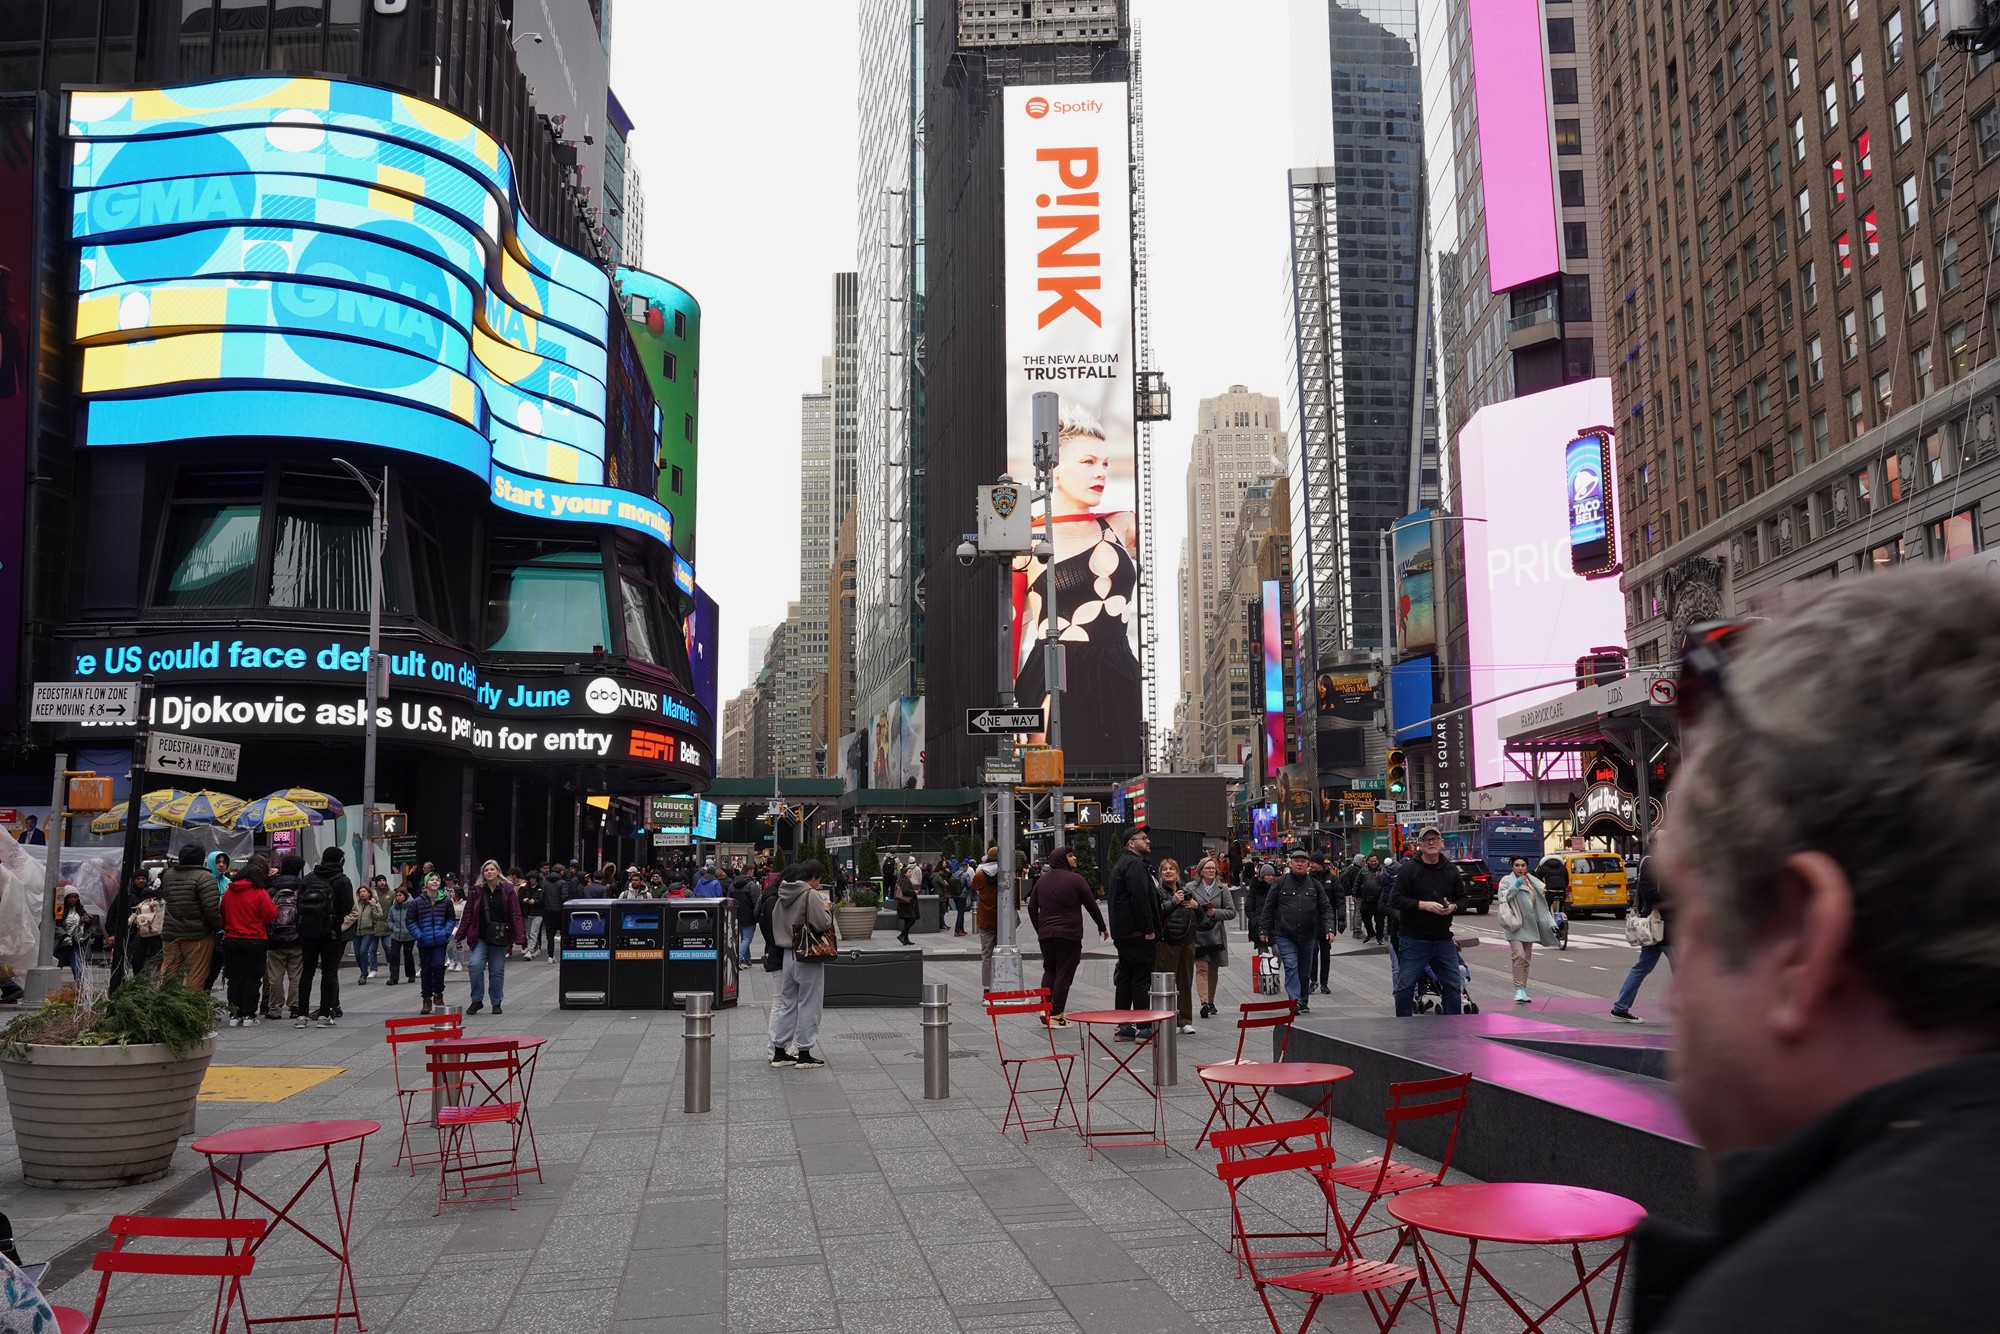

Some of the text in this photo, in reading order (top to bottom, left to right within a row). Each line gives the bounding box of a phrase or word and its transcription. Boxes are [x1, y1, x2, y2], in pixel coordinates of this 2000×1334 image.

[1053, 99, 1103, 115] Spotify
[93, 176, 245, 230] GMA
[1036, 147, 1102, 331] P!NK
[278, 262, 438, 349] GMA
[1023, 354, 1119, 365] THE NEW ALBUM
[1024, 367, 1117, 381] TRUSTFALL
[494, 476, 545, 509] Start
[551, 494, 612, 516] your
[1573, 499, 1600, 515] TACO
[1576, 512, 1601, 526] BELL
[76, 654, 97, 675] e
[105, 646, 142, 674] US
[148, 641, 220, 672] could
[228, 641, 307, 669] face
[317, 643, 426, 678] defult
[431, 660, 454, 682] on
[38, 687, 128, 699] PEDESTRIAN FLOW ZONE
[477, 681, 571, 710] rly June
[1608, 687, 1623, 705] LIDS
[35, 704, 85, 716] KEEP MOVING
[163, 695, 306, 730] Djokovic
[315, 699, 393, 728] asks
[401, 702, 447, 733] U.S.
[590, 689, 618, 701] abc
[621, 687, 658, 712] NEWS
[663, 694, 690, 723] Marine
[979, 716, 1035, 727] ONE WAY
[1521, 702, 1564, 728] HARD ROCK CAFE
[159, 739, 236, 760] PEDESTRIAN FLOW ZONE
[498, 727, 537, 750] for
[544, 728, 613, 755] entry
[629, 729, 675, 762] ESPN
[1437, 715, 1448, 768] SQUAR
[195, 759, 234, 775] KEEP MOVING
[653, 802, 694, 810] TARBUCKS
[1588, 788, 1602, 816] Hard
[1603, 787, 1619, 815] Rock
[266, 818, 307, 829] SABRETT
[655, 811, 684, 819] COFFEE
[274, 831, 291, 842] OPEN
